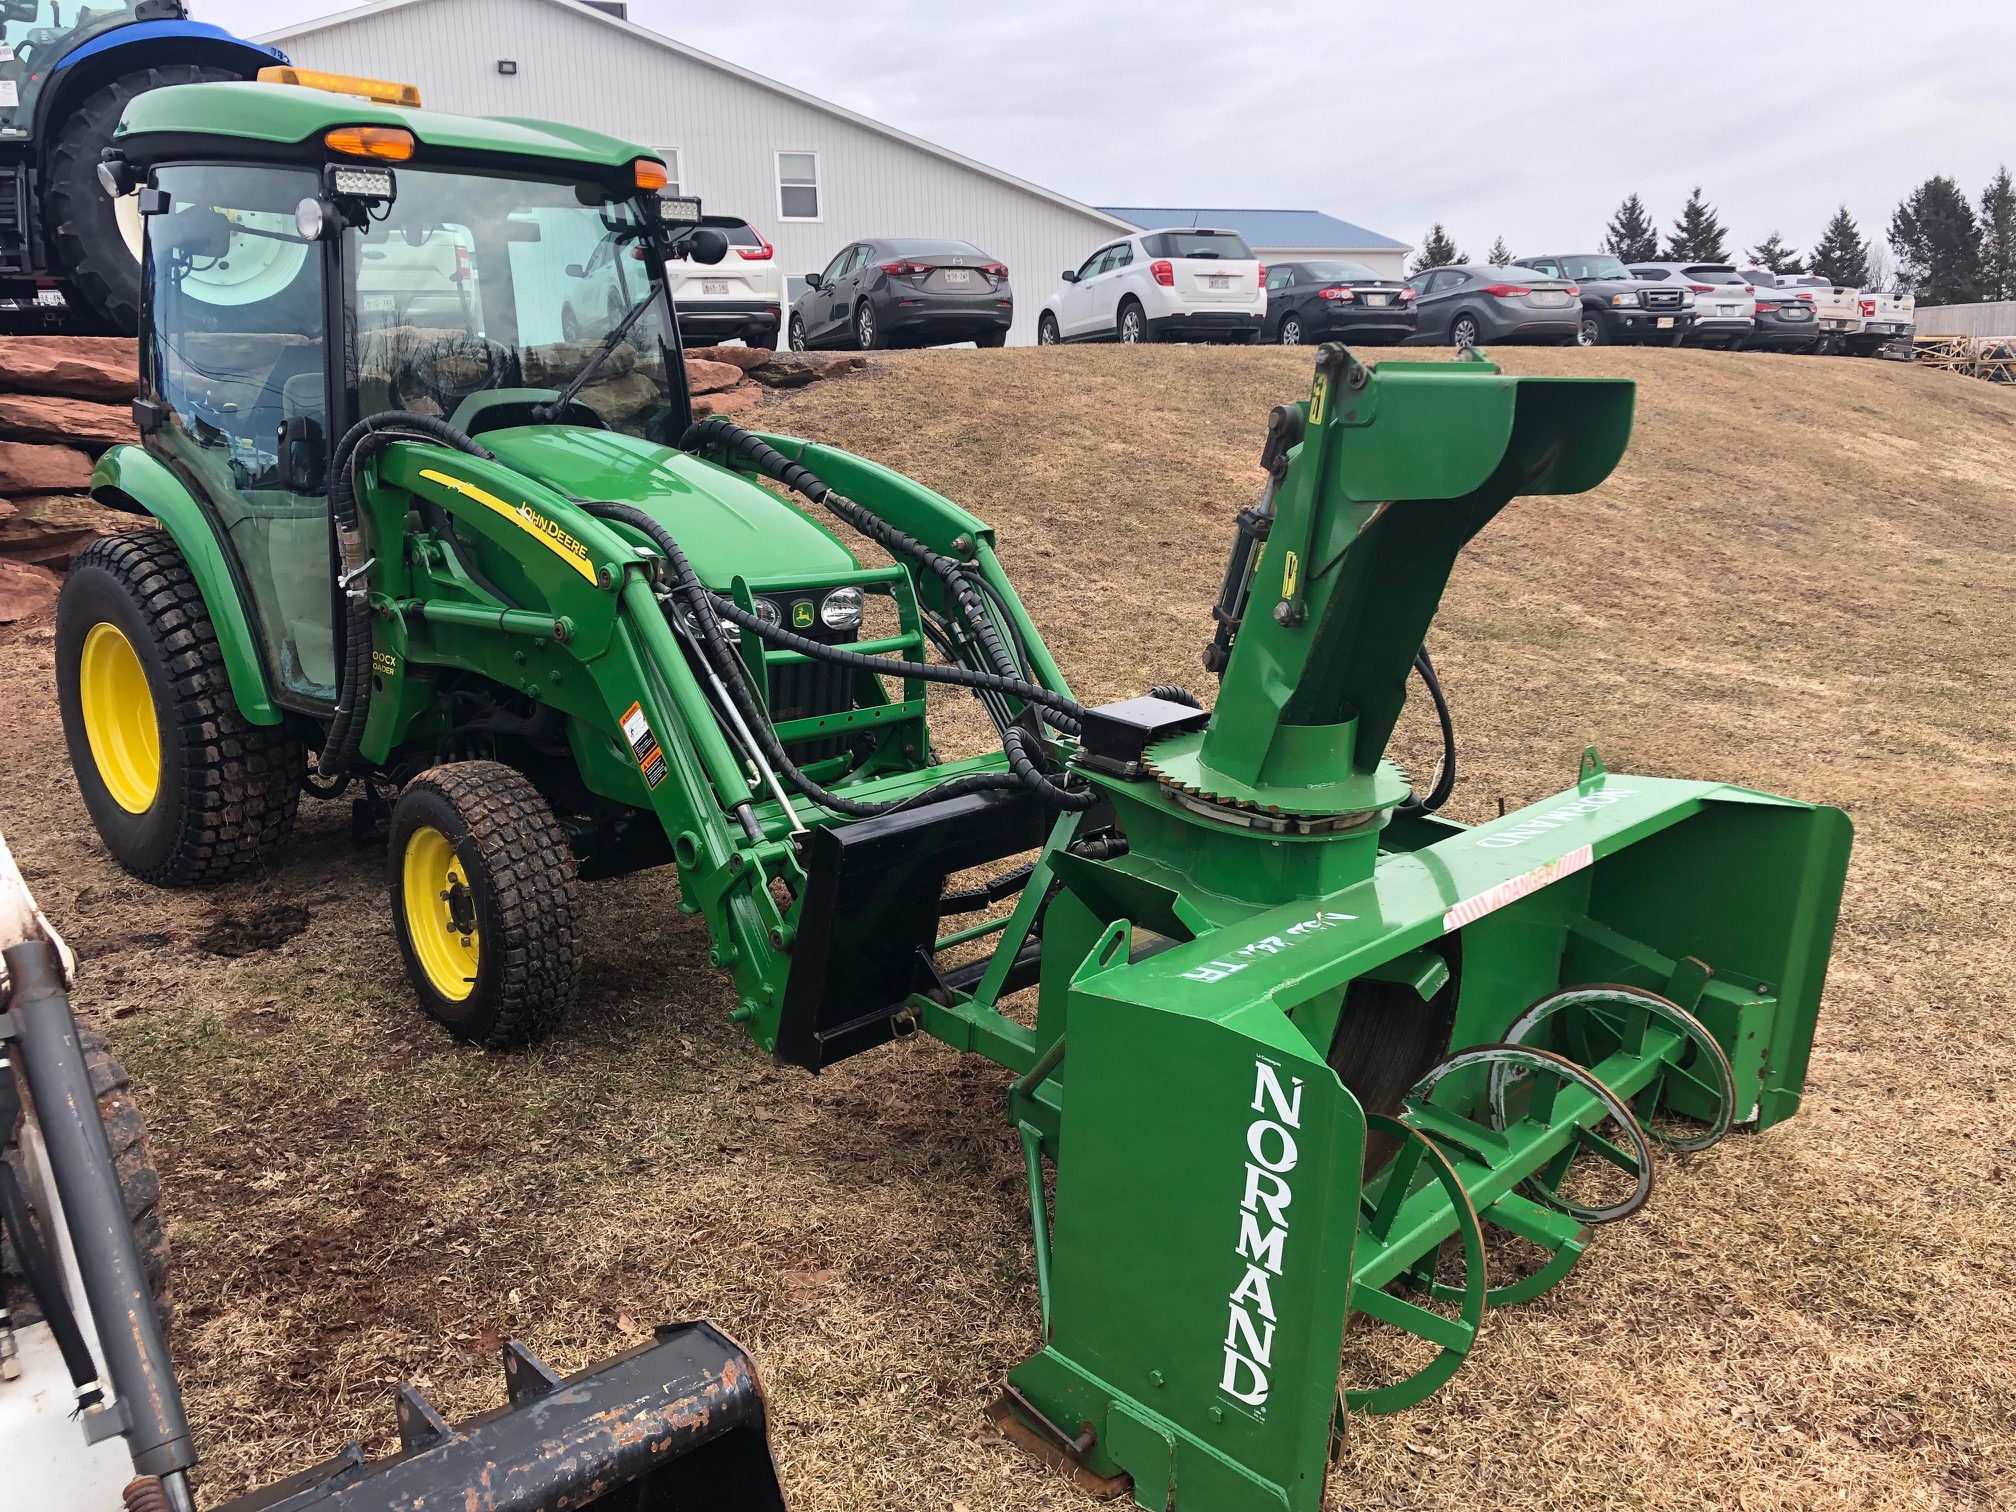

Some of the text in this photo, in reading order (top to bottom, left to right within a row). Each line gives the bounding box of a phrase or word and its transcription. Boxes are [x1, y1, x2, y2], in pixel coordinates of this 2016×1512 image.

[516, 501, 589, 560] JOHN DEERE
[372, 650, 396, 667] 00CX
[372, 662, 395, 676] OADER
[1475, 787, 1640, 848] NORMAND
[1501, 864, 1554, 905] DANGER
[1219, 1060, 1304, 1406] NORMAND
